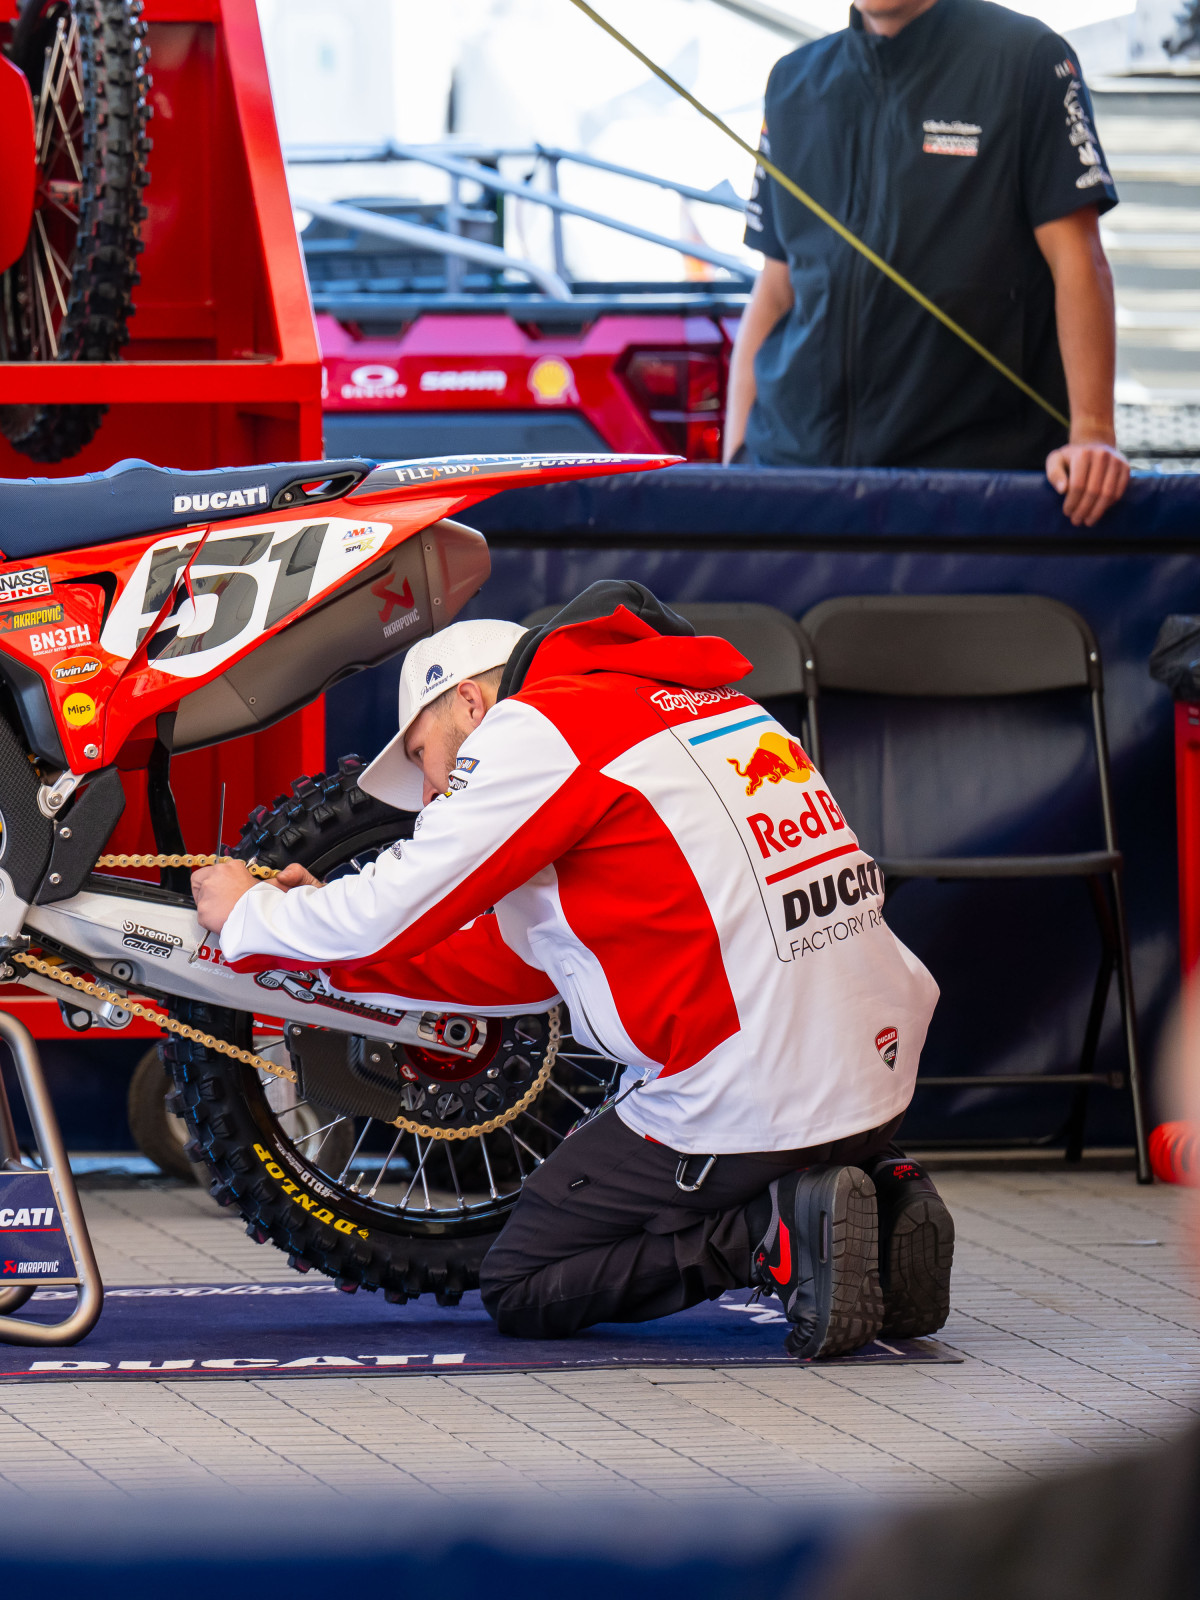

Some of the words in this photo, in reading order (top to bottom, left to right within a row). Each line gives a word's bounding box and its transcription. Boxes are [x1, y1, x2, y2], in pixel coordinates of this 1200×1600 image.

[173, 485, 267, 513] DUCATI
[343, 527, 373, 540] AMA
[137, 523, 330, 665] 51
[29, 624, 90, 652] BN3TH
[55, 666, 81, 679] Twin
[82, 662, 98, 674] Air
[67, 703, 91, 715] Mips
[746, 792, 827, 859] Red
[136, 925, 181, 946] brembo
[790, 913, 865, 960] FACTORY
[122, 938, 171, 959] GALFER
[877, 1031, 895, 1045] DUCATI
[253, 1143, 358, 1235] DUNLOP
[28, 1352, 466, 1371] DUCATI
